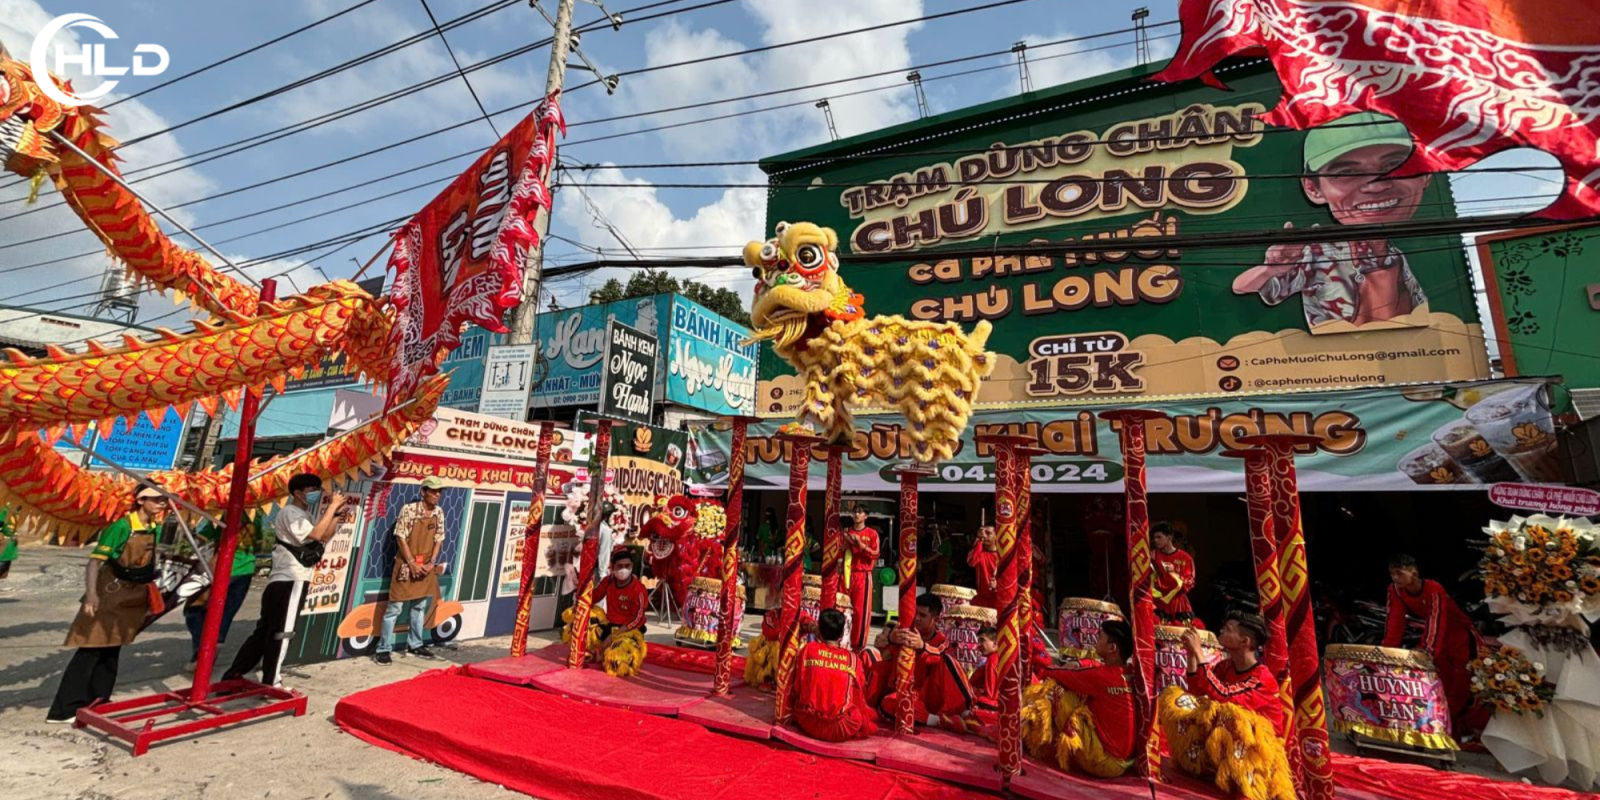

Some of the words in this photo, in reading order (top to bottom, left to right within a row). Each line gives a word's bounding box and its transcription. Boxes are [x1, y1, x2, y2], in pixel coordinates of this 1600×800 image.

[843, 166, 950, 213] TRẠM
[960, 143, 1094, 183] DỪNG
[1106, 103, 1257, 156] CHÂN
[854, 188, 986, 253] CHÚ
[1004, 162, 1240, 221] LONG
[910, 285, 1010, 320] CHÚ
[1023, 264, 1181, 311] LONG
[546, 312, 616, 370] Hạn
[613, 328, 637, 351] BÁNH
[637, 336, 655, 358] KEM
[673, 303, 721, 347] BÁNH
[724, 328, 755, 361] KEM
[1037, 337, 1077, 355] CHỈ
[1082, 336, 1117, 352] TỪ
[610, 349, 648, 385] Ngọc
[1251, 346, 1460, 366] CaPheMuoiChuLong@gmail.com
[1029, 352, 1143, 394] 15K
[1254, 373, 1386, 388] @caphemuoichulong
[612, 382, 650, 416] Hạnh
[446, 427, 486, 443] CHÚ
[329, 555, 347, 570] LẬP
[320, 592, 340, 606] DO
[1359, 673, 1425, 698] HUỲNH
[1378, 698, 1415, 721] LÂN
